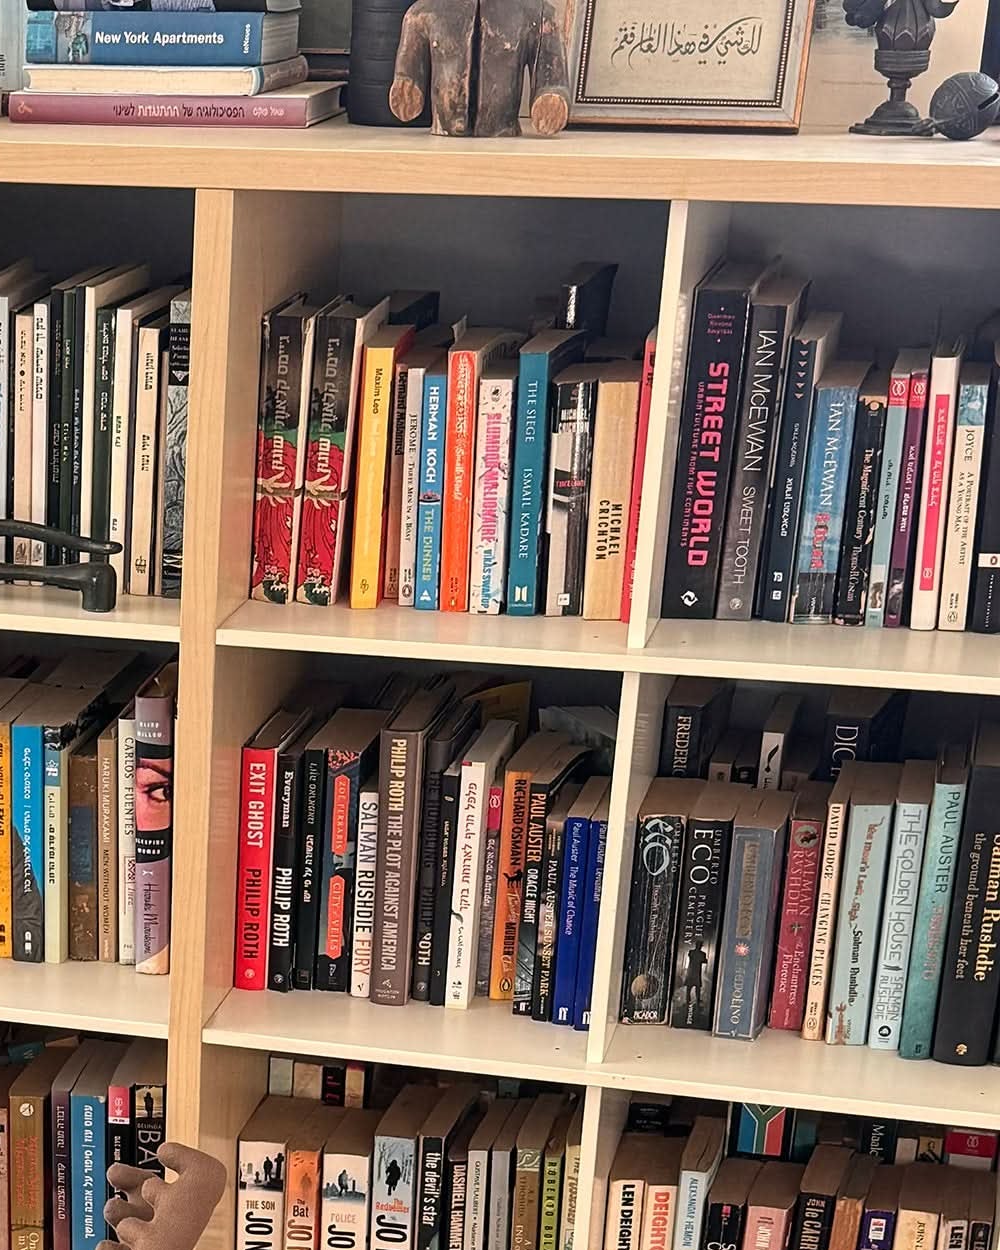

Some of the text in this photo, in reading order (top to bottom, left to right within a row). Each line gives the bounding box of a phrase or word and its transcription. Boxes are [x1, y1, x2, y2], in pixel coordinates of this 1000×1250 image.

[95, 32, 224, 46] New York Apartments
[138, 106, 179, 117] ההתנגדות
[182, 106, 193, 117] של
[196, 106, 245, 119] הפסיכולוגיה
[34, 347, 43, 373] שירים
[34, 376, 44, 400] שונים
[407, 413, 418, 453] JEROME
[731, 329, 778, 585] IAN McEWAN SWEET TOOTH
[964, 429, 976, 462] JOYCE
[421, 386, 440, 582] HERMAN KOCH THE DINNER
[518, 380, 538, 559] THE SIEGE ISMAIL KADARE
[679, 381, 705, 548] URBAN CULTURE FROM FIVE CONTINENTS
[686, 362, 730, 567] STREET WORLD
[595, 499, 610, 561] CRICHTON
[607, 503, 623, 556] MICHAEL
[281, 770, 294, 828] Everyman
[101, 758, 112, 934] HARUKI MURAKAMI MEN WITHOUT WOMEN
[243, 762, 267, 960] EXIT GHOST PHILIP ROTH
[381, 739, 407, 971] PHILIP ROTH THE PLOT AGAINST AMERICA
[523, 793, 546, 924] PAUL AUSTER ORACLE NIGHT
[689, 828, 714, 884] ECO
[709, 829, 722, 885] UMBERTO
[353, 802, 377, 975] SALMAN RUSHDIE FURY
[564, 822, 582, 935] Paul Auster The Music of Chance
[810, 806, 841, 987] DAVID LODGE CHANGING PLACES
[273, 867, 293, 948] PHILIP ROTH
[683, 886, 697, 946] CEMETERY
[694, 894, 706, 939] PRAGUE
[705, 910, 713, 924] THE
[82, 1105, 95, 1239] עמוס עוז סיפור על אהבה וחושך
[422, 1152, 441, 1227] the devil's star
[451, 1164, 466, 1209] DASHIELL
[621, 1184, 636, 1207] LEN
[18, 1235, 28, 1246] in
[244, 1212, 273, 1235] JO
[286, 1219, 312, 1241] JO
[327, 1224, 356, 1249] JO
[376, 1215, 408, 1242] JO
